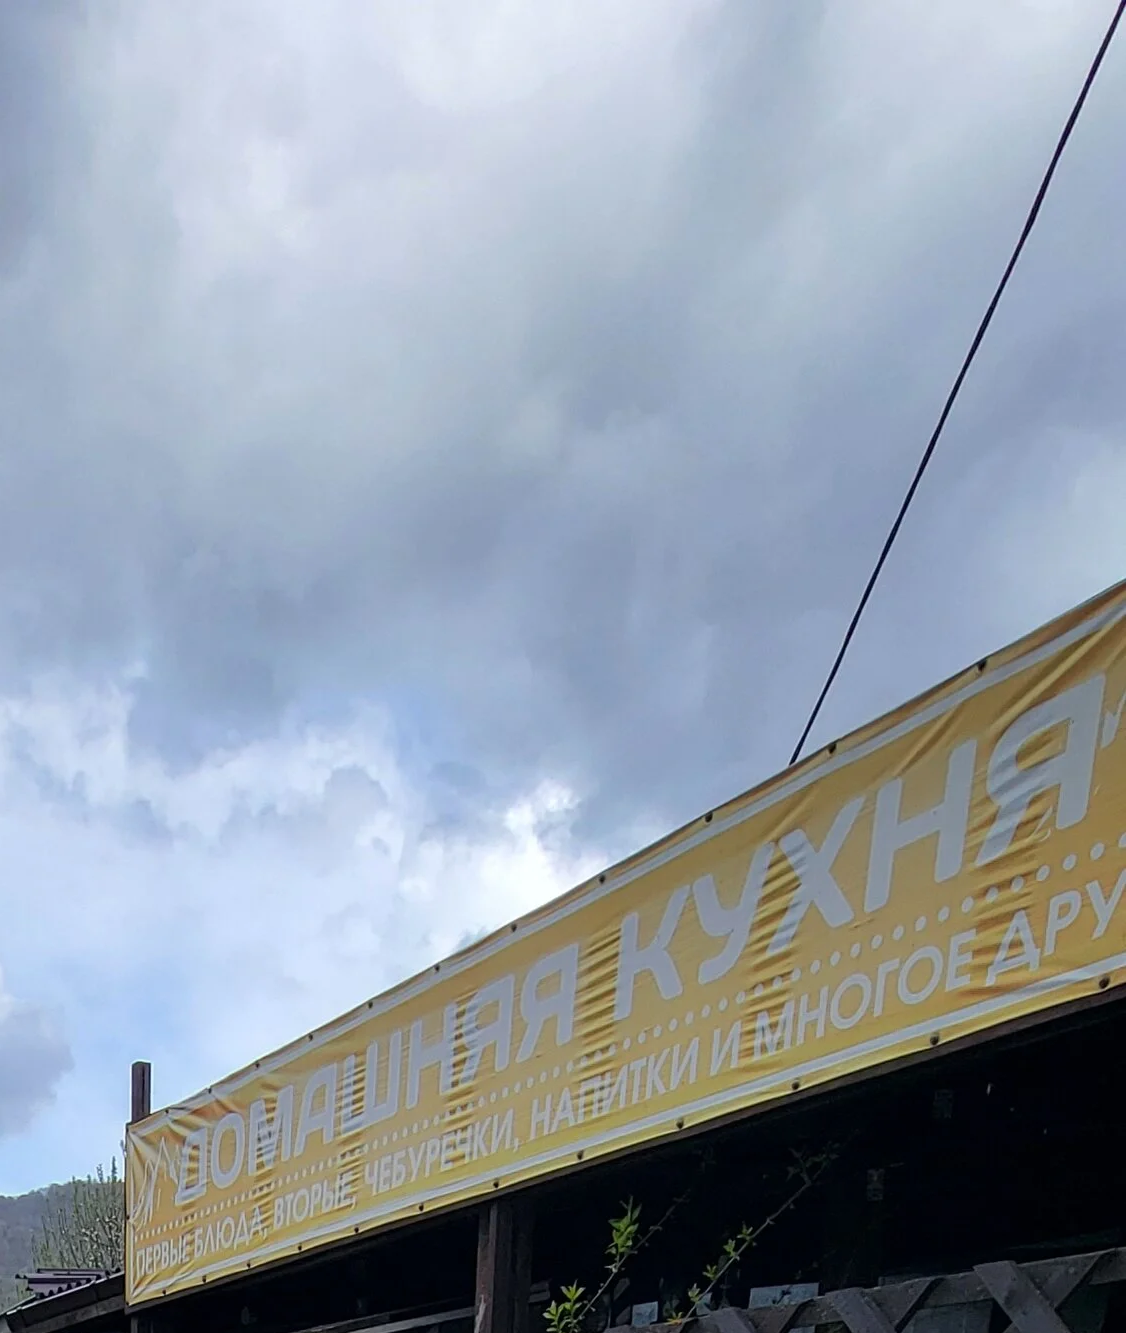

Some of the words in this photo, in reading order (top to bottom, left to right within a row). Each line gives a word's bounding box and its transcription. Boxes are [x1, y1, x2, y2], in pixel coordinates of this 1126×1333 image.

[136, 1231, 192, 1277] ПЕРВЫЕ
[193, 1205, 269, 1259] БЛЮДА,
[274, 1170, 357, 1228] ВТОРЫЕ,
[364, 1108, 523, 1195] ЧЕБУРЕЧКИ,
[530, 1032, 699, 1140] НАПИТКИ
[709, 1020, 743, 1077] И
[752, 929, 977, 1056] МНОГОЕ
[175, 943, 579, 1206] ДОМАШНЯЯ
[614, 673, 1105, 1021] КУХНЯ
